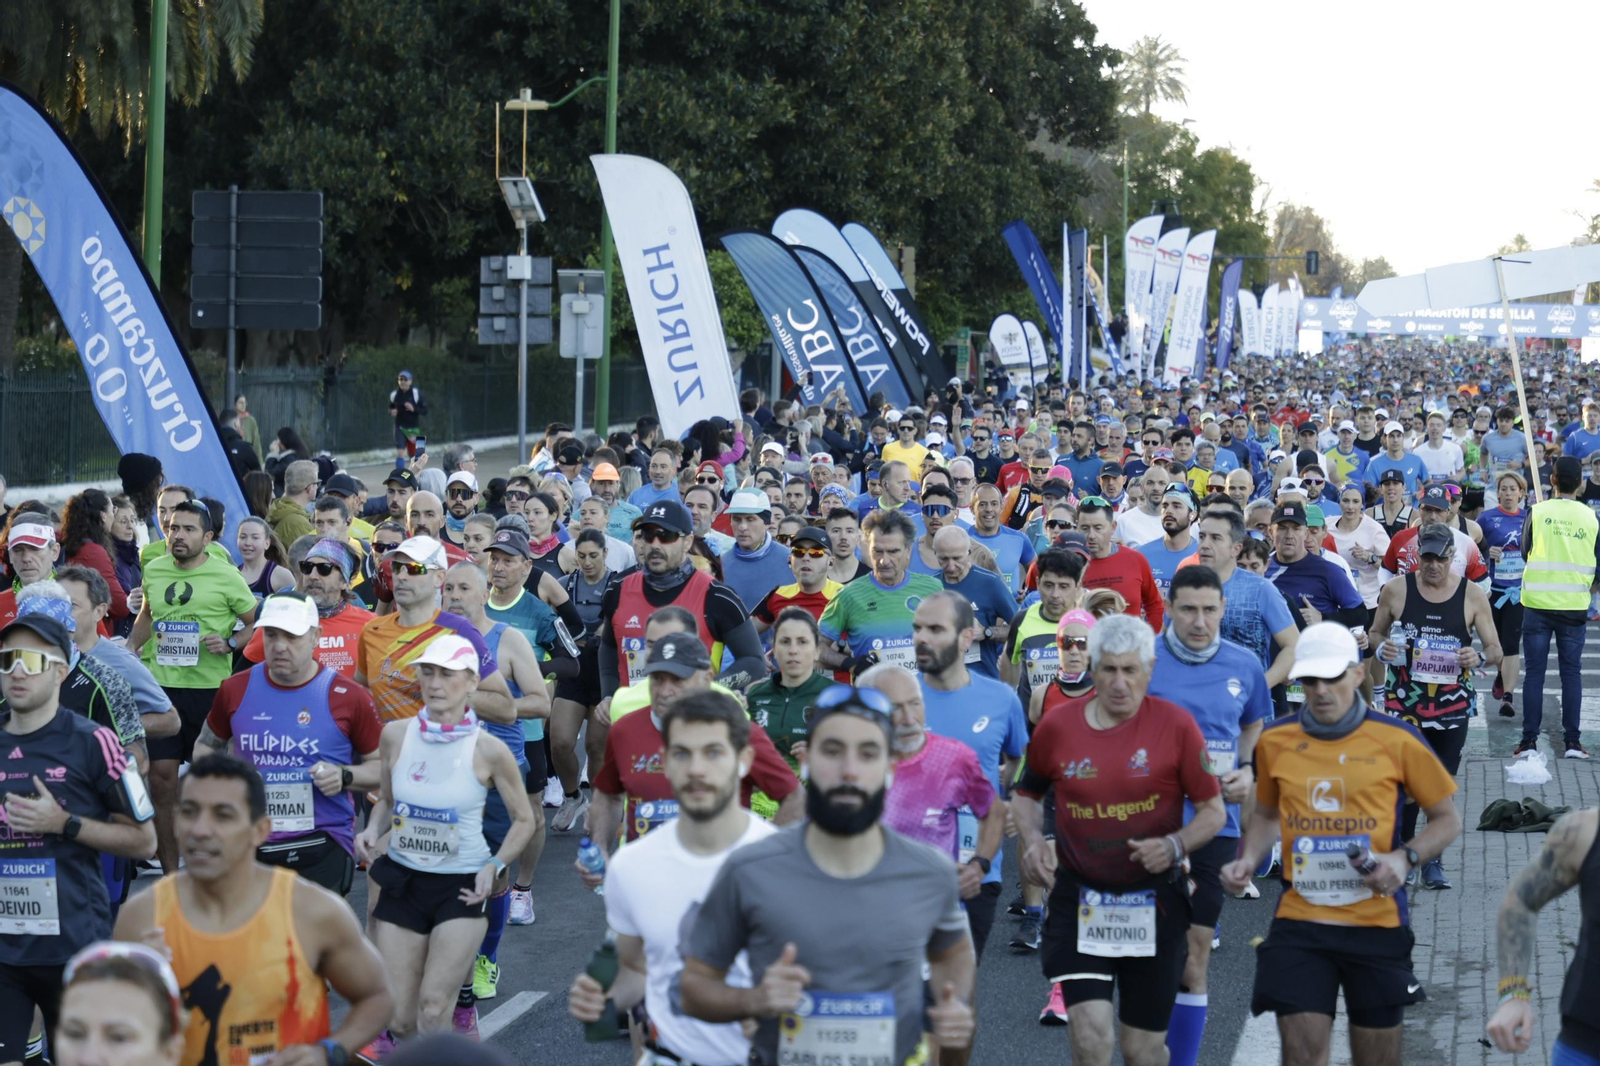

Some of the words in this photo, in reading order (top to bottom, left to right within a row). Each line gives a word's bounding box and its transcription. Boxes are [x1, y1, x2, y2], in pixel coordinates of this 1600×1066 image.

[1471, 307, 1488, 319] DE
[1489, 308, 1536, 321] SEILLA
[1264, 306, 1274, 351] ZURICH
[886, 639, 914, 647] ZURICH
[157, 645, 198, 655] CHRISTIAN
[1416, 662, 1455, 674] PAPIJAVI
[240, 730, 320, 756] FILÍPIDES
[253, 754, 305, 767] PARADAS
[266, 772, 304, 782] ZURICH
[266, 791, 291, 800] 11253
[268, 803, 306, 816] RMAN
[413, 808, 451, 822] ZURICH
[657, 804, 680, 815] ZUR
[1286, 811, 1378, 836] Montepio
[413, 825, 438, 837] 12079
[398, 836, 451, 854] SANDRA
[2, 864, 46, 875] ZURICH
[3, 886, 30, 897] 11641
[1294, 880, 1327, 892] PAULO
[1104, 894, 1146, 905] ZURICH
[0, 901, 42, 916] DEIVID
[1086, 926, 1148, 941] ANTONIO
[819, 998, 884, 1015] ZURICH
